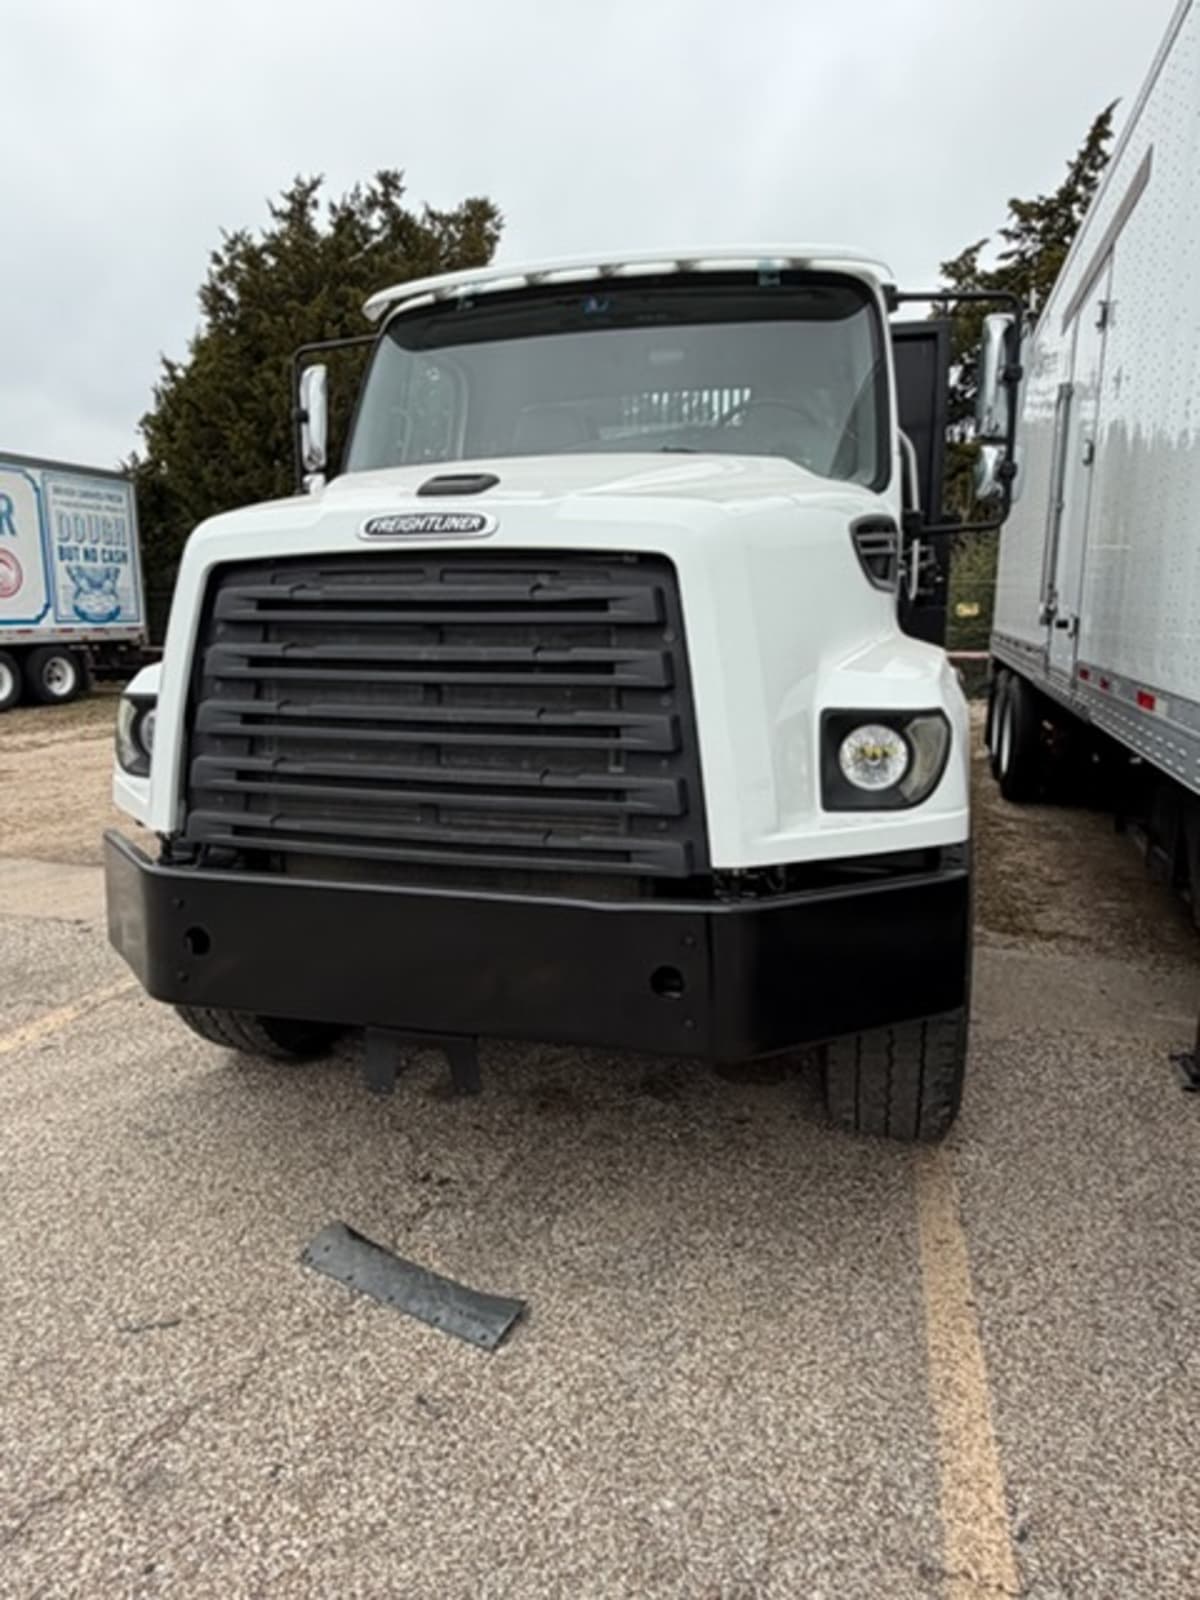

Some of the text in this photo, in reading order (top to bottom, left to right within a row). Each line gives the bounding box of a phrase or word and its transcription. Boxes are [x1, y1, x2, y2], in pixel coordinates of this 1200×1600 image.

[369, 516, 481, 533] FREIGHTLINER
[83, 547, 98, 563] NO
[101, 548, 128, 564] CASH
